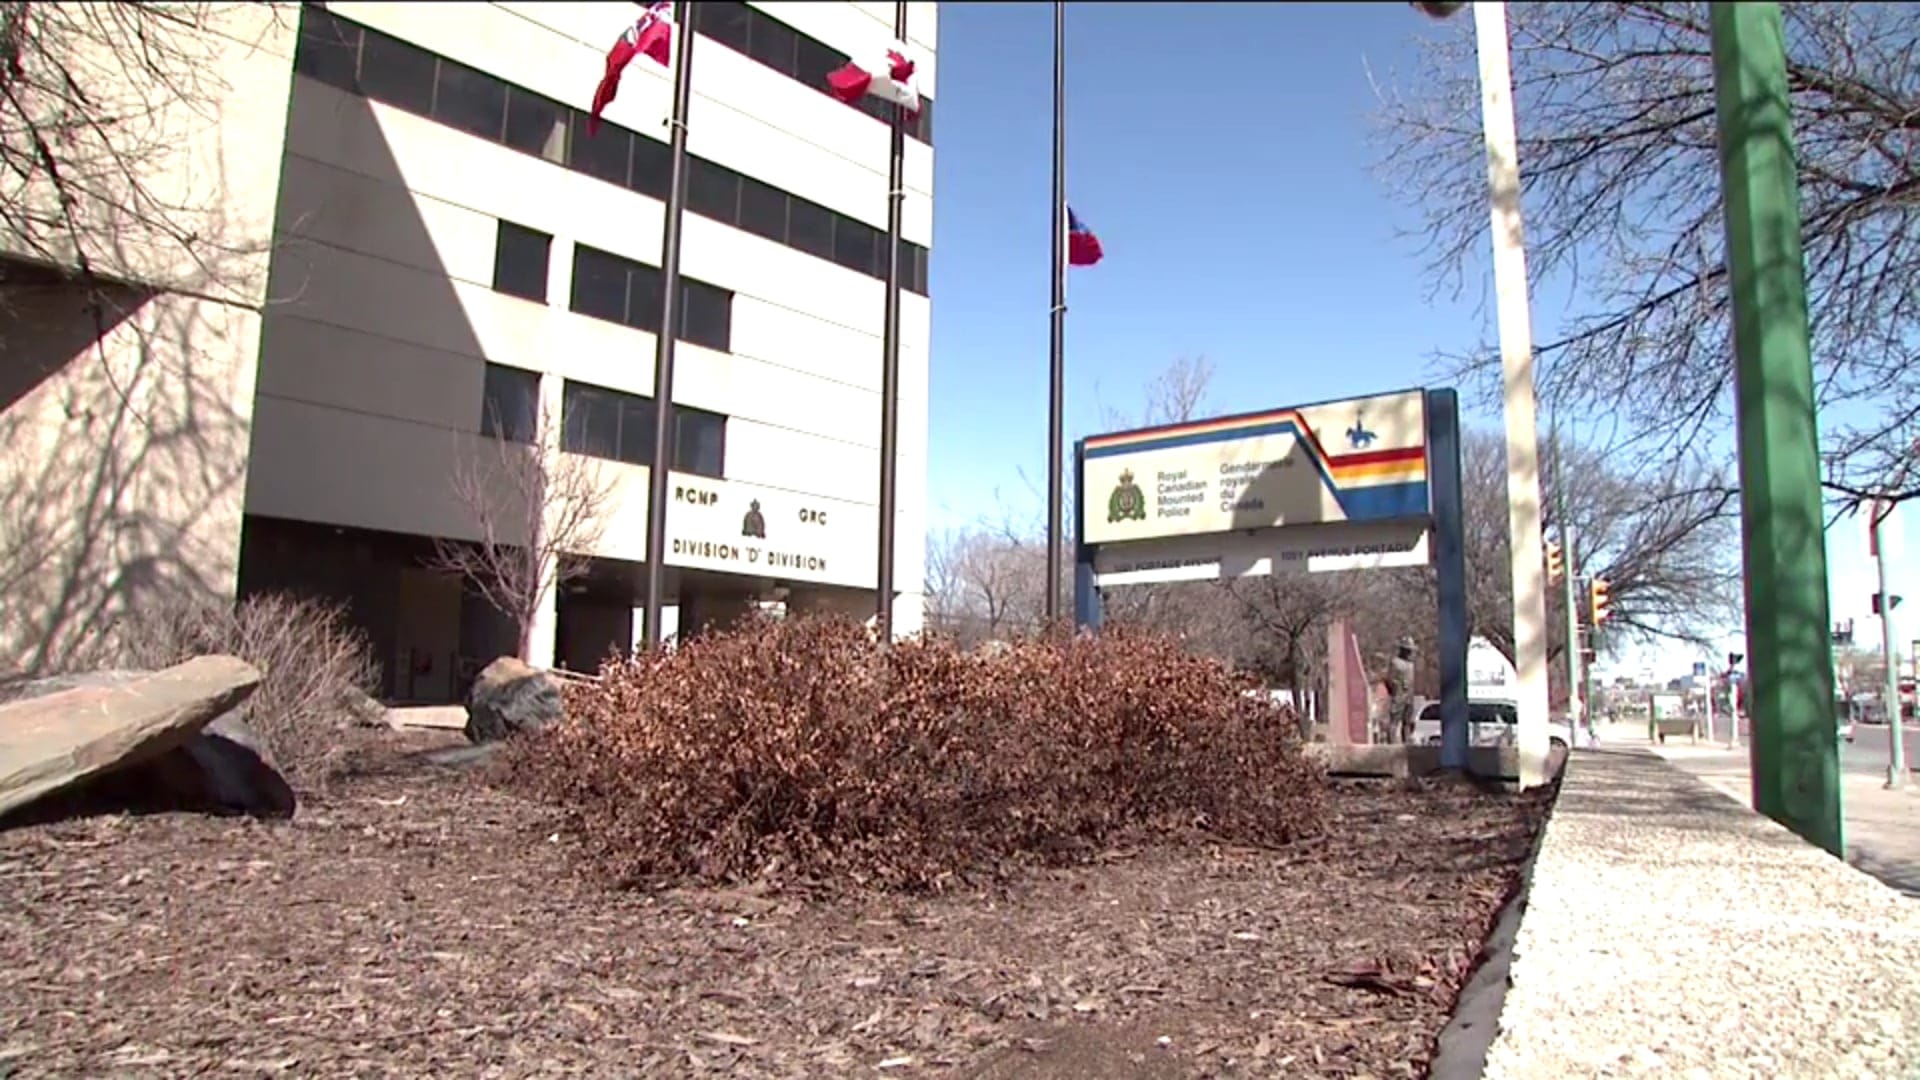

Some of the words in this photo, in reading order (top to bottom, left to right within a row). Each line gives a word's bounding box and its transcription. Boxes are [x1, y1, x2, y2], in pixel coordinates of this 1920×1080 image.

[1158, 470, 1187, 483] Royal
[1158, 480, 1208, 494] Canadian
[1220, 488, 1235, 499] du
[675, 486, 718, 506] RCMP
[1158, 493, 1205, 506] Mounted
[1158, 506, 1191, 518] Police
[1220, 498, 1265, 512] Canada
[798, 507, 827, 526] GRC
[673, 538, 739, 560] DIVISION
[768, 551, 826, 571] DIVISION
